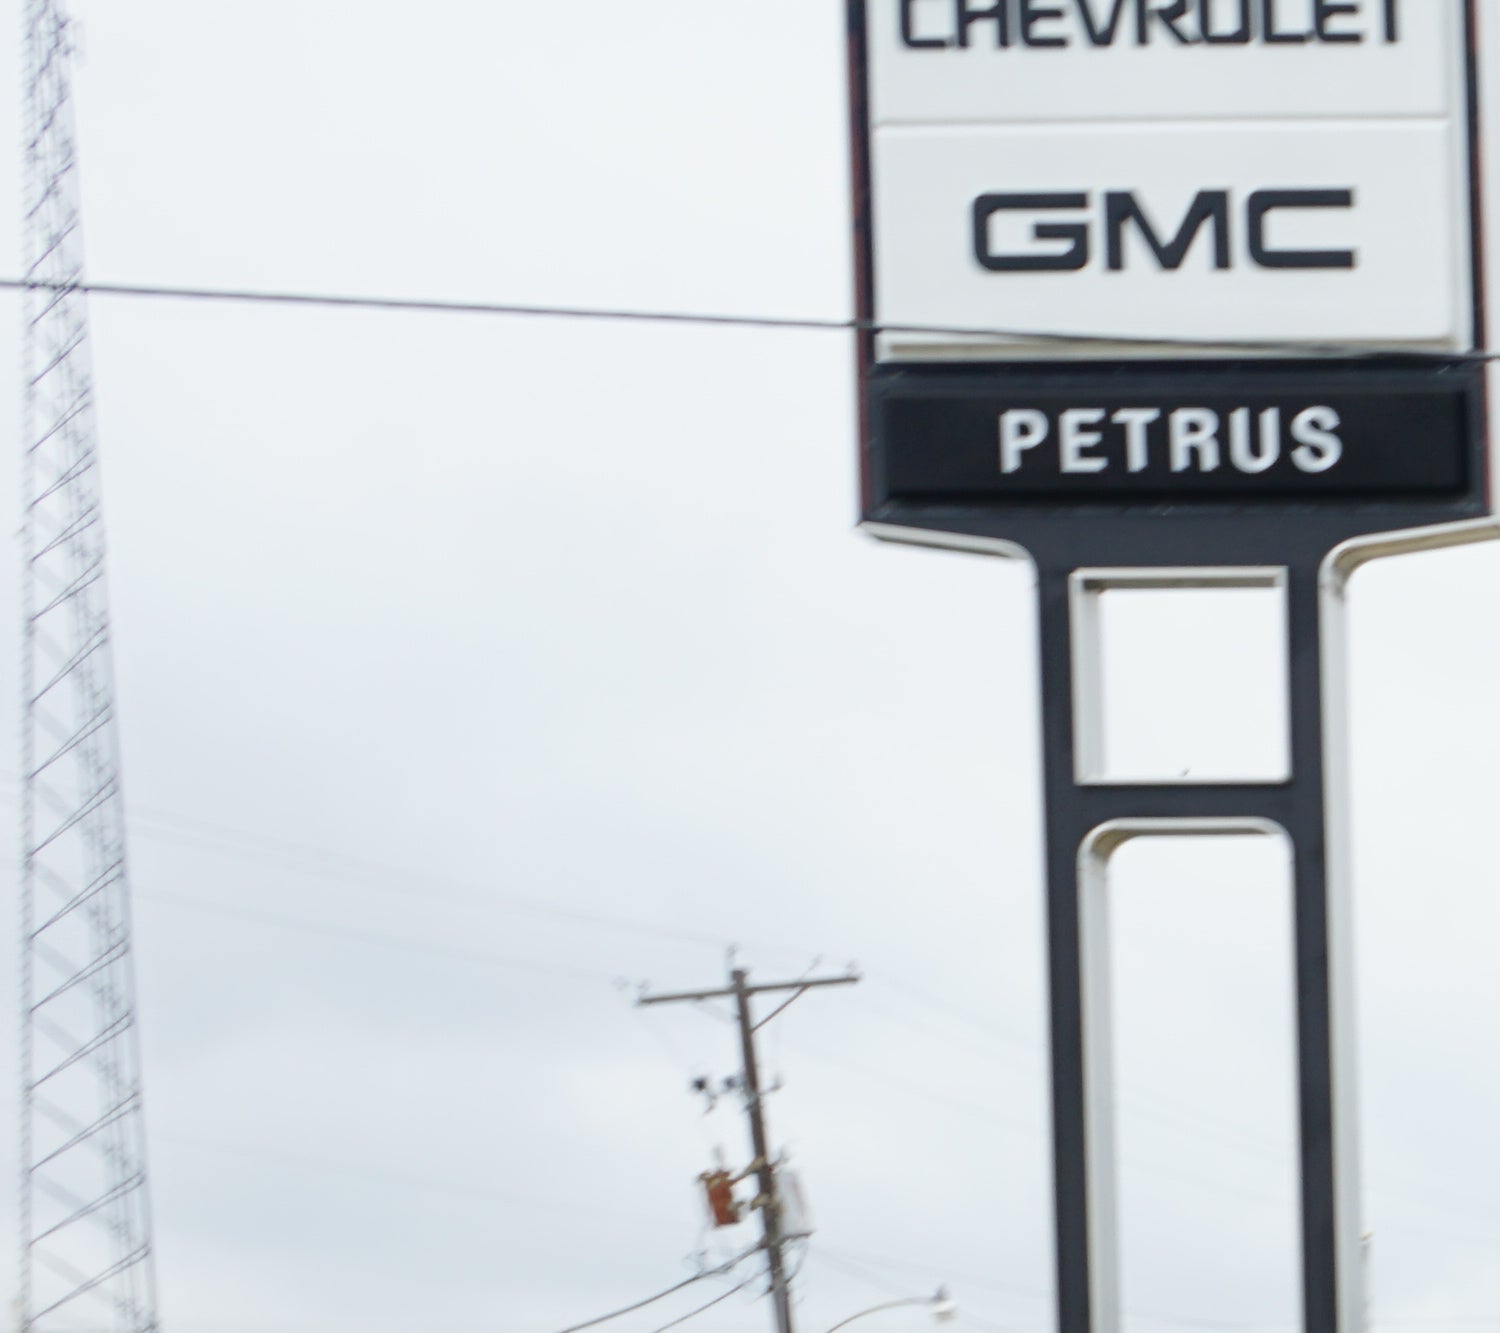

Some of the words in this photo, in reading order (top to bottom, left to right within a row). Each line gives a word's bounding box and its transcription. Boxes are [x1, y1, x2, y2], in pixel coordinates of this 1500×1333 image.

[899, 0, 1401, 48] CHEVROLET
[971, 188, 1355, 272] GMC
[1000, 405, 1343, 475] PETRUS
